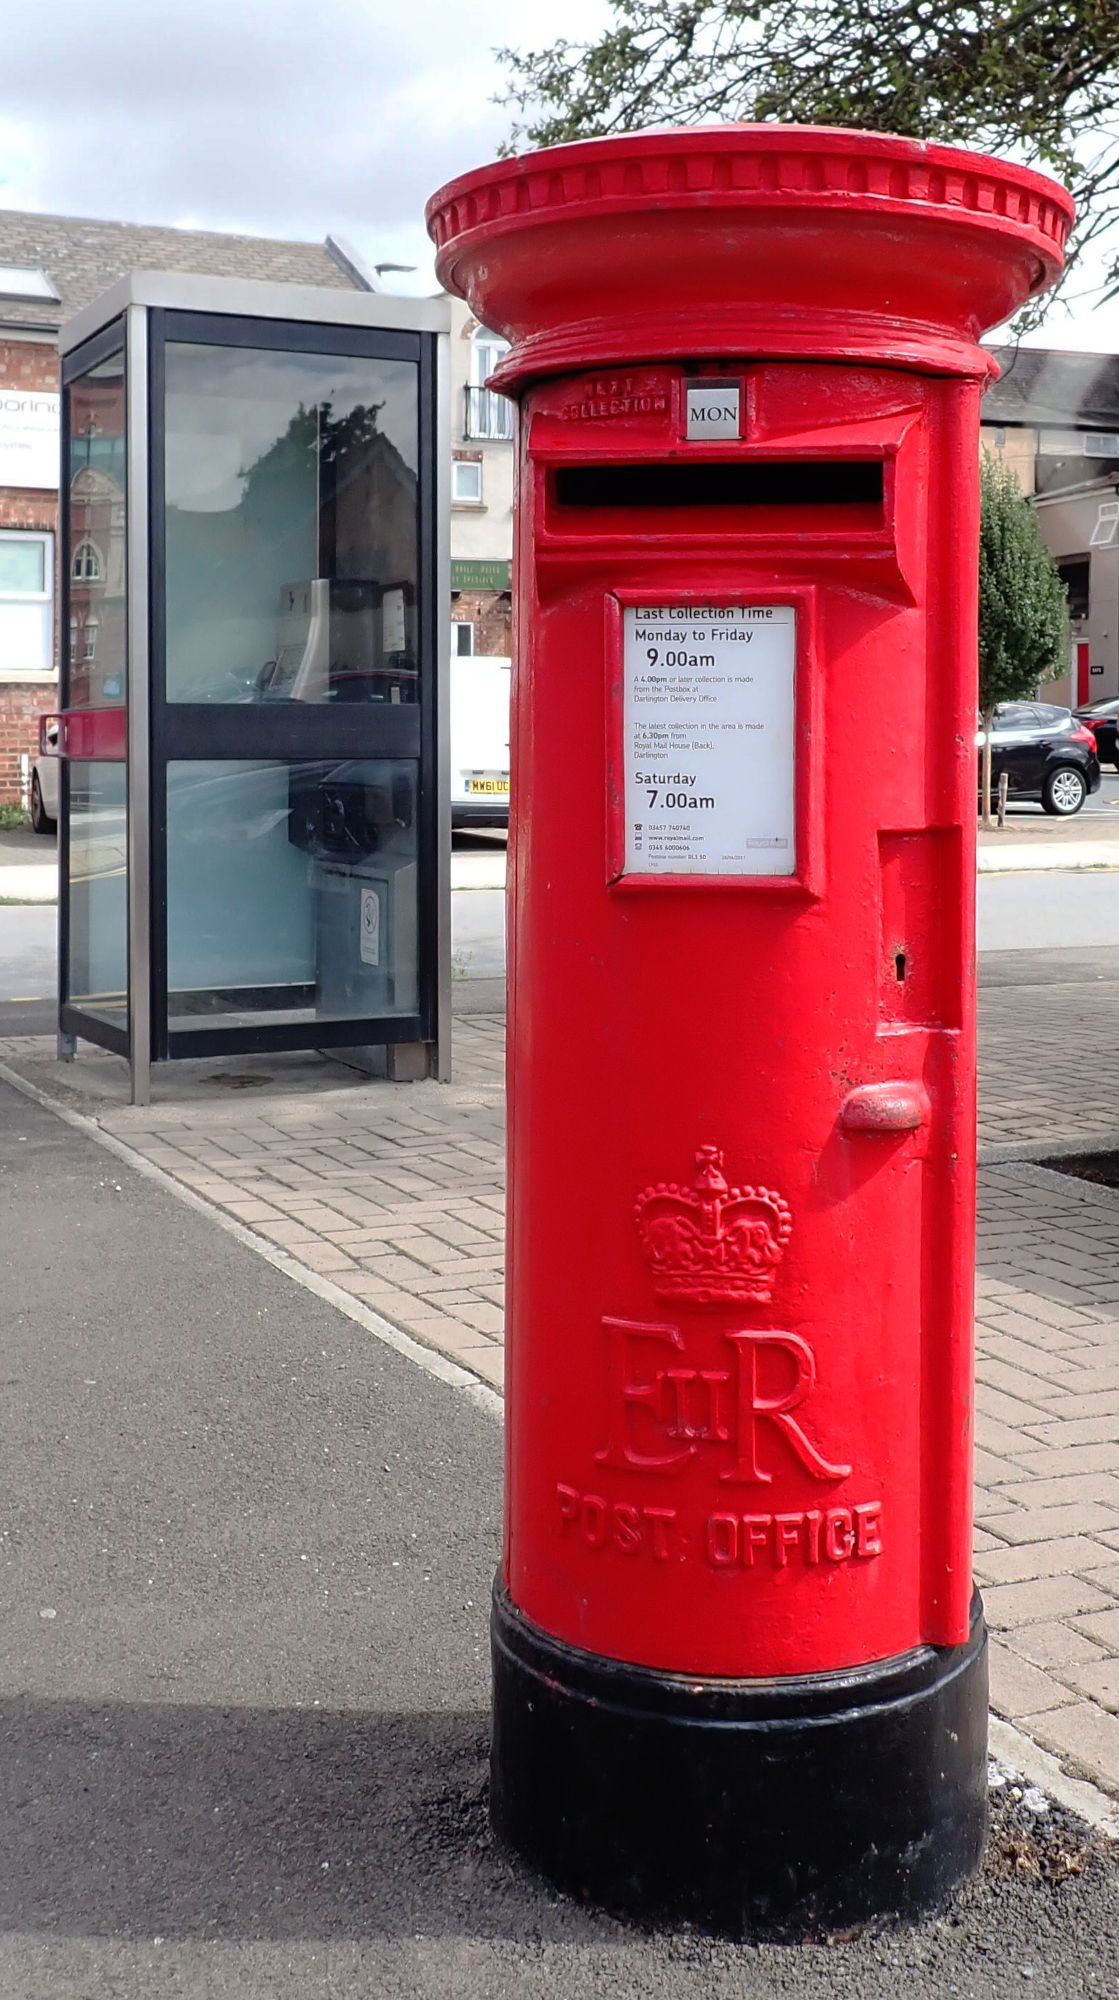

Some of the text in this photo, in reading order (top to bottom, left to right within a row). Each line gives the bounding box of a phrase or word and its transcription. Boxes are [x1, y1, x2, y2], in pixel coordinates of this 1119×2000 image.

[559, 396, 667, 421] COLLECTION
[690, 407, 737, 422] MON
[635, 608, 773, 620] Last Collection Time
[635, 629, 753, 643] Monday to Friday
[647, 648, 715, 667] 9.00am
[641, 676, 667, 684] 4.00pm
[634, 695, 668, 703] Darlington
[670, 695, 696, 703] Delivery
[634, 742, 652, 750] Royal
[634, 752, 669, 760] Darlington
[472, 780, 495, 791] MW61
[635, 772, 696, 786] Saturday
[646, 790, 715, 808] 7.00am
[556, 1482, 885, 1567] POST OFFICE
